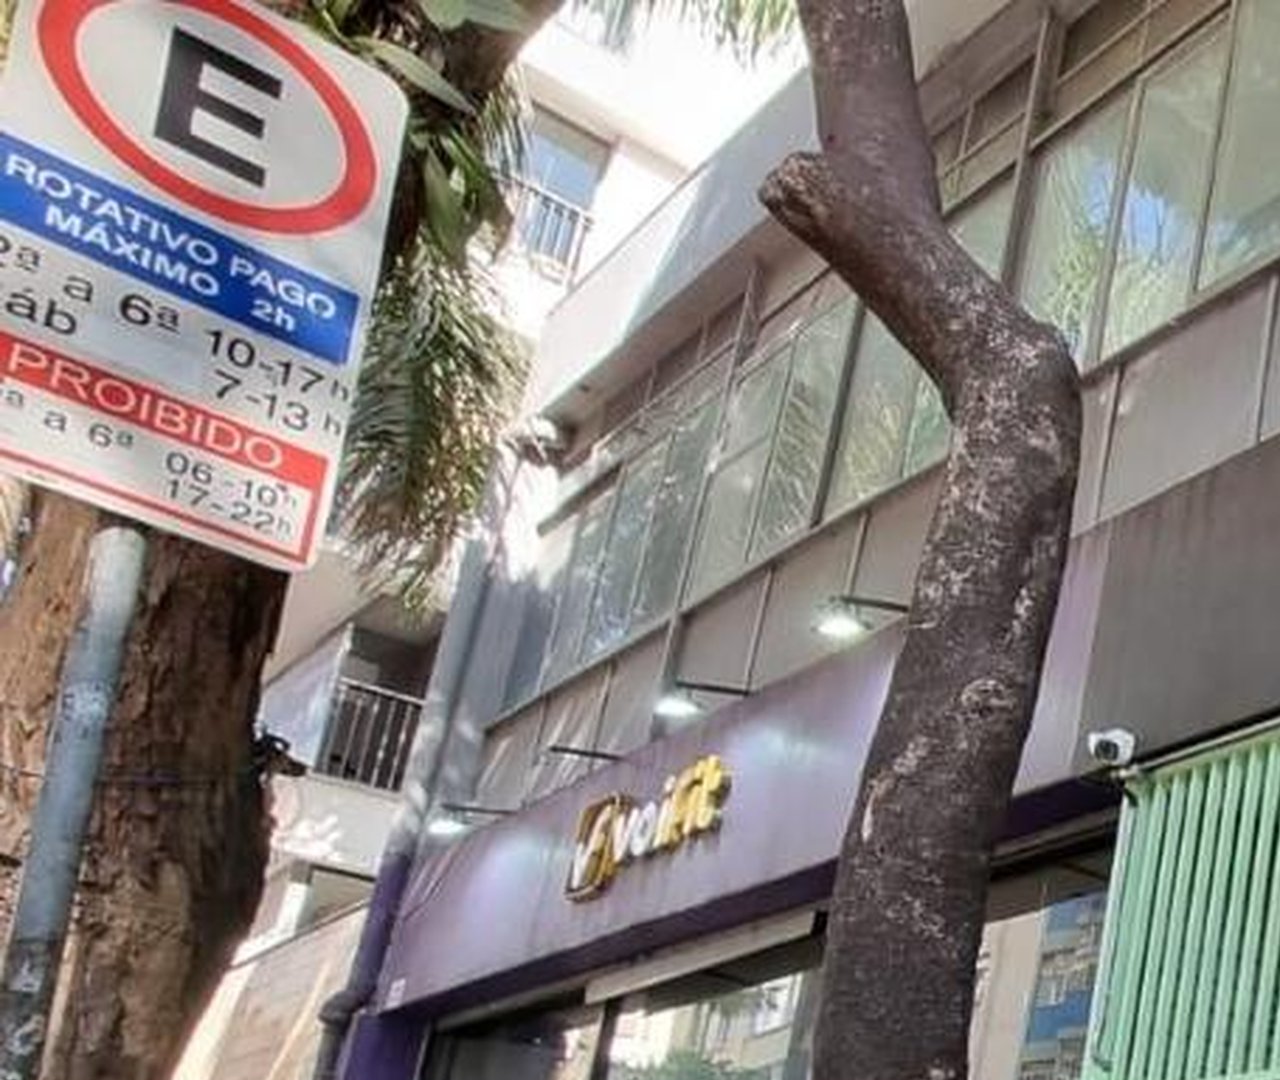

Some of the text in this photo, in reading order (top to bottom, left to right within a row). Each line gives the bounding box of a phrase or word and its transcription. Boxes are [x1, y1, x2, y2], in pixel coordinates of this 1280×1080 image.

[154, 26, 283, 189] E
[5, 153, 337, 319] ROTATIVO PAGO
[45, 203, 296, 332] MÁXIMO 2h
[62, 275, 94, 302] a
[4, 286, 78, 335] áb
[9, 342, 283, 471] PROIBIDO
[43, 410, 68, 433] a
